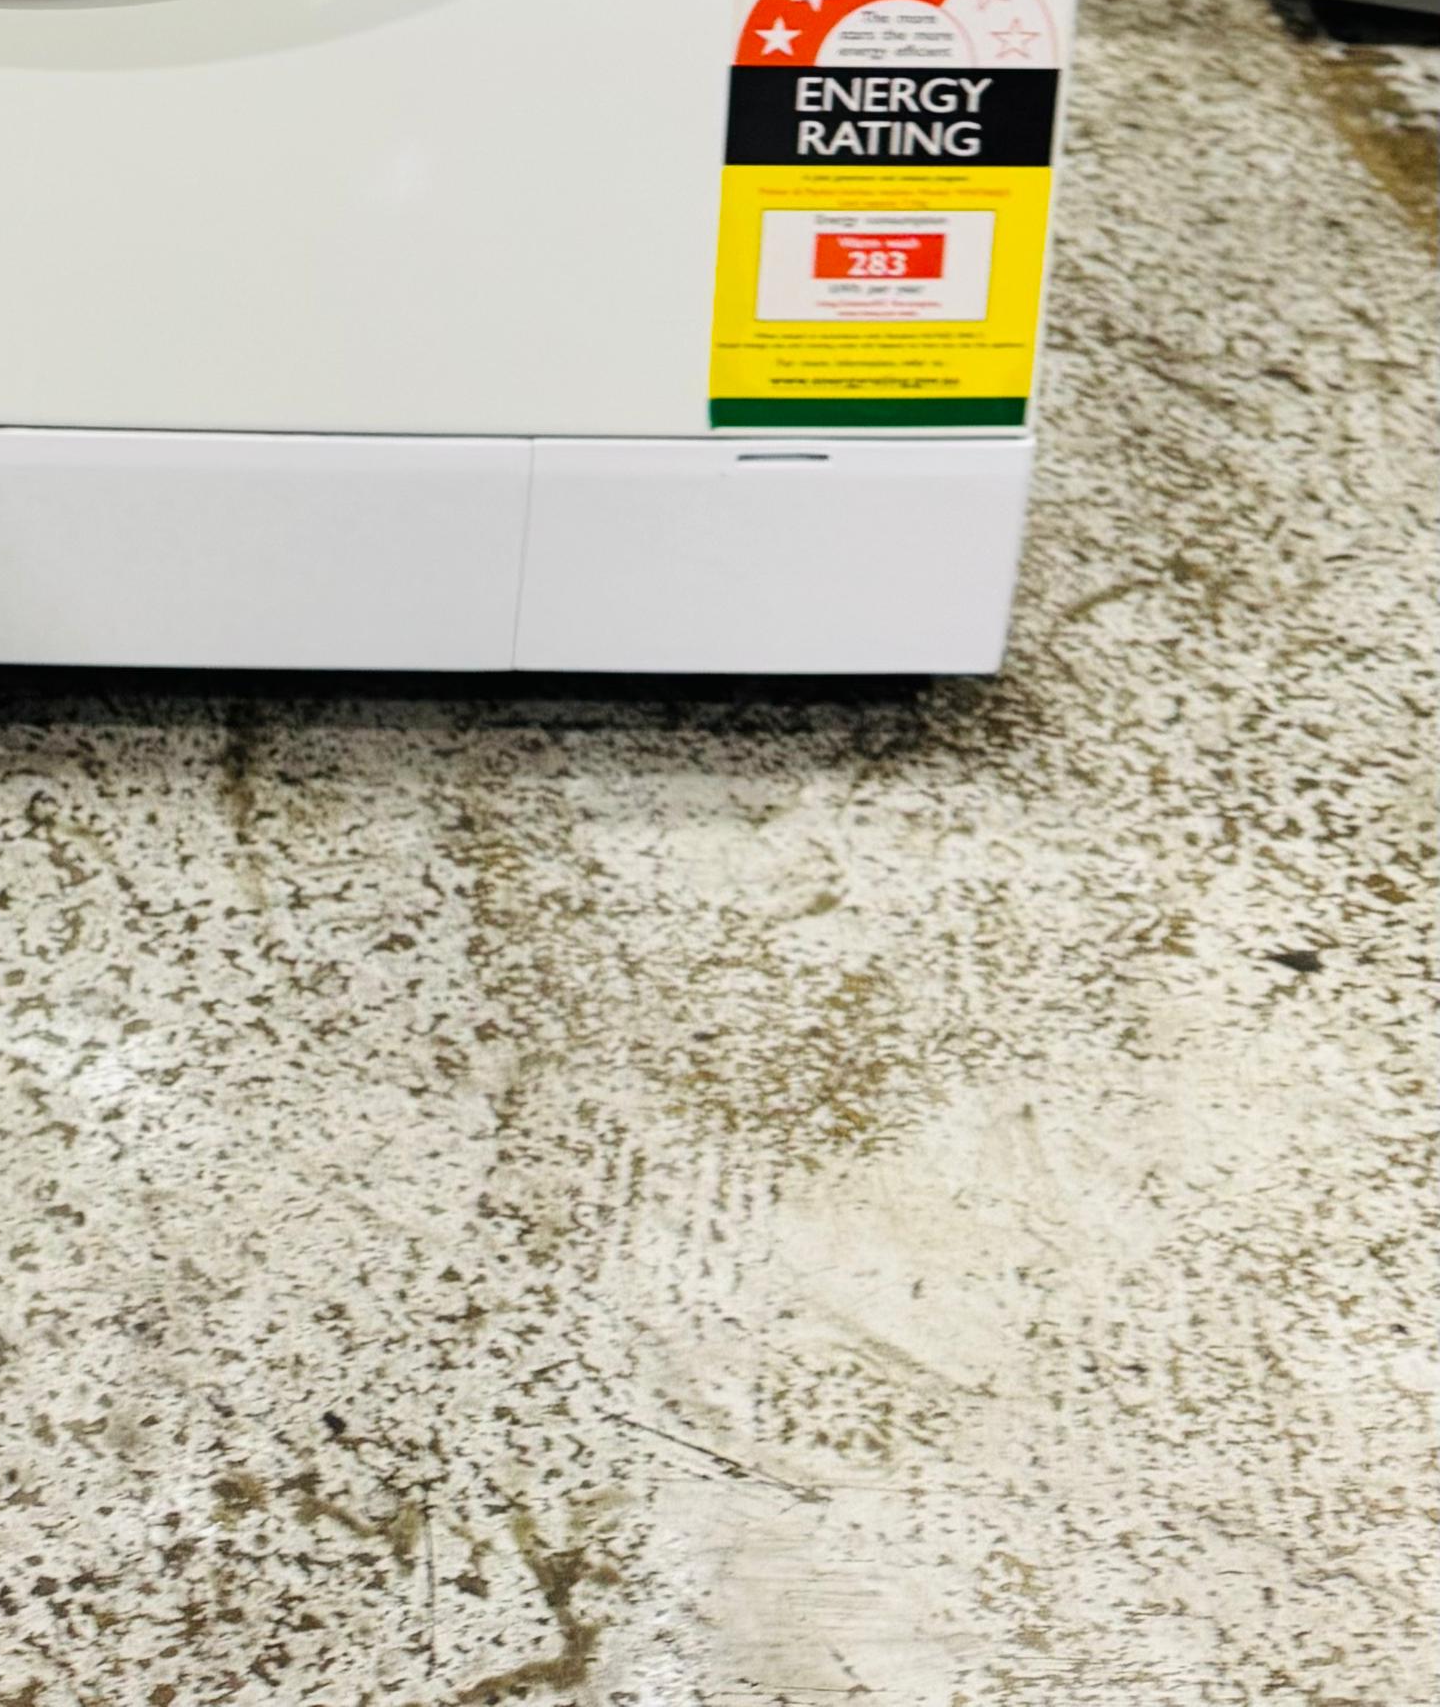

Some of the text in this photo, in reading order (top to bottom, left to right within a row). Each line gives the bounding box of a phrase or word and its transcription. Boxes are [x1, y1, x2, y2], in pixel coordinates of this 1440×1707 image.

[794, 76, 992, 113] ENERGY
[796, 120, 982, 157] RATING
[847, 251, 908, 276] 283
